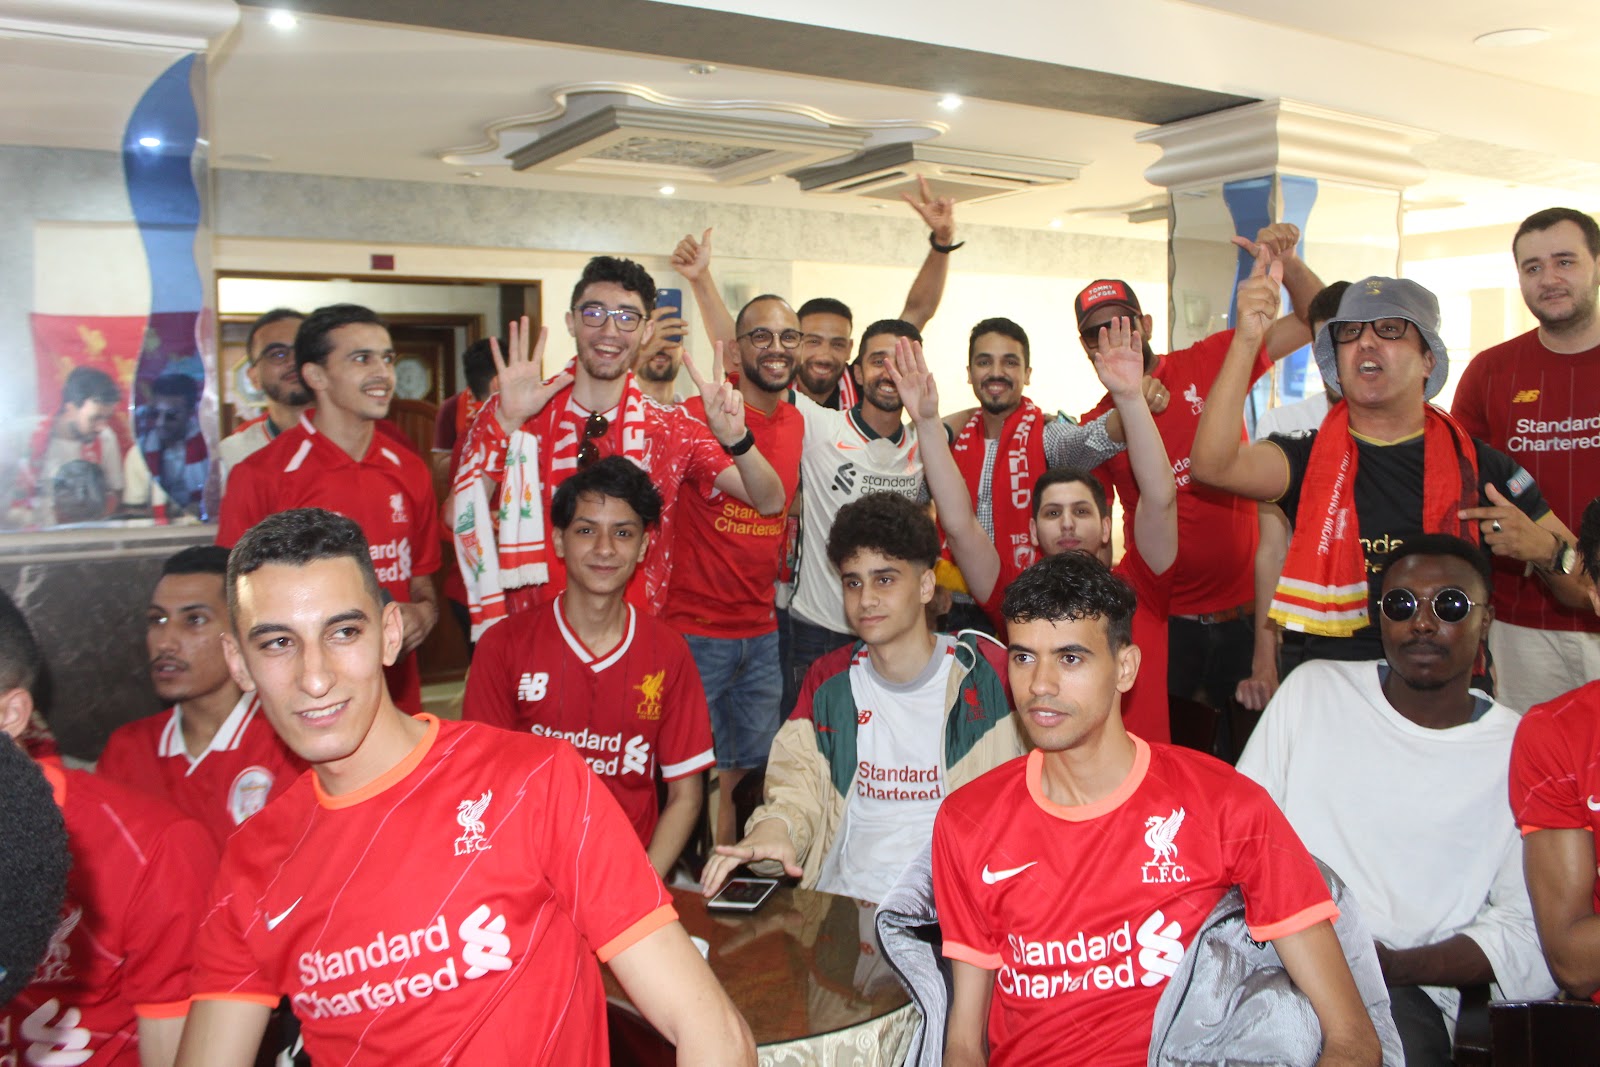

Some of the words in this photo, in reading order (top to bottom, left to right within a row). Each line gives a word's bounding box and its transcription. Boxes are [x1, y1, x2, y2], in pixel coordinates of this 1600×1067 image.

[1515, 414, 1600, 434] Standard
[1508, 432, 1600, 452] Chartered
[714, 516, 784, 536] Chartered
[858, 761, 938, 783] Standard
[857, 780, 941, 801] Chartered
[1141, 864, 1191, 884] L.F.C.
[298, 914, 450, 987] Standard
[1008, 920, 1132, 967] Standard
[997, 956, 1136, 999] Chartered
[292, 957, 460, 1020] Chartered
